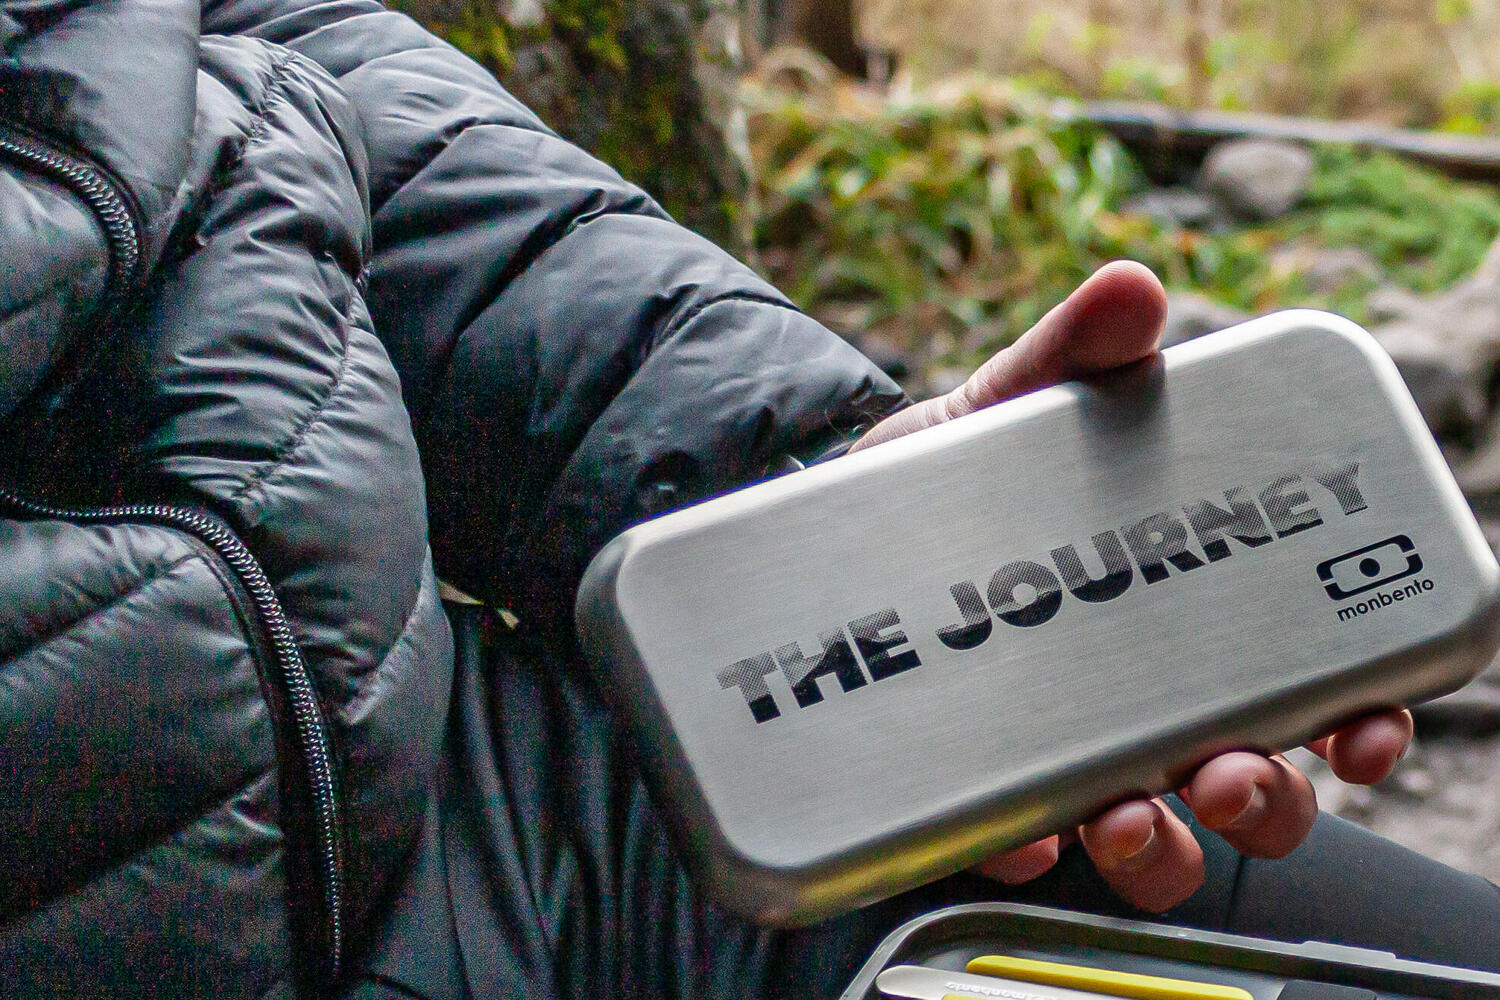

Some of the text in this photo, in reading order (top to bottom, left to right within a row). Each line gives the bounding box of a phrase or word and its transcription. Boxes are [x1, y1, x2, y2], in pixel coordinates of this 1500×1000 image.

[716, 461, 1369, 725] THE JOURNEY
[1336, 579, 1434, 622] monbento
